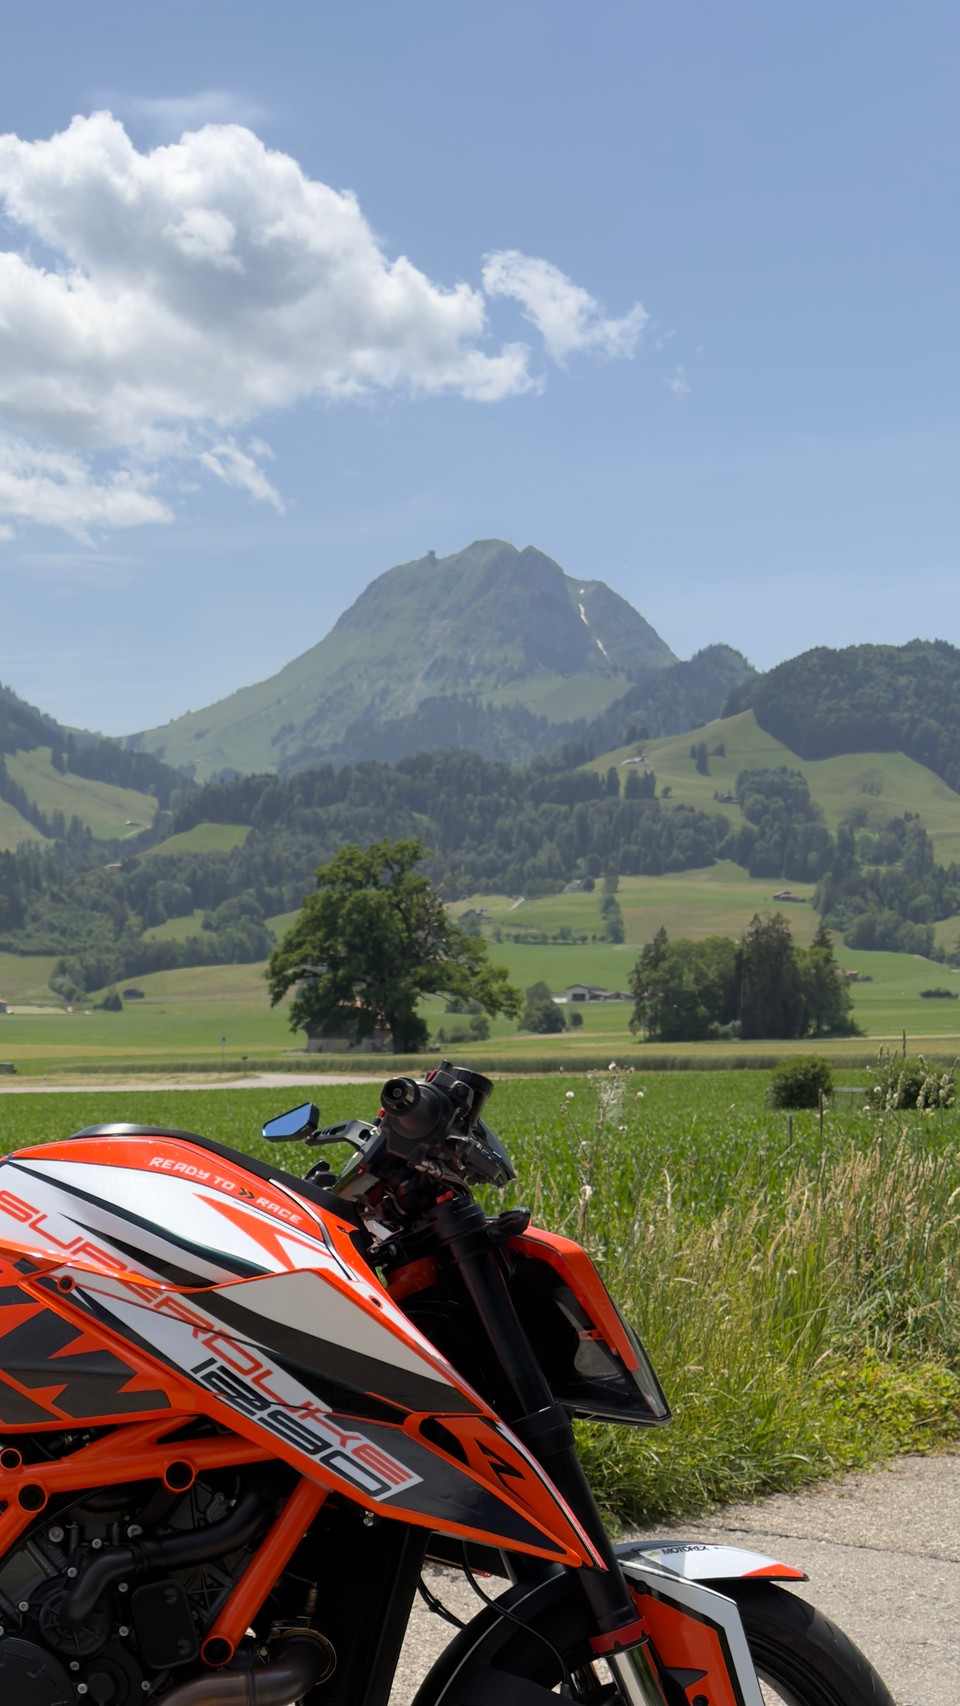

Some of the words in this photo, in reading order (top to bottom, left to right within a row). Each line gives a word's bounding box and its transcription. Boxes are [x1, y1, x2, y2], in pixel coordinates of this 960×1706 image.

[149, 1157, 211, 1180] READY
[213, 1174, 236, 1191] TO
[255, 1197, 303, 1224] RACE
[190, 1357, 393, 1499] 1290
